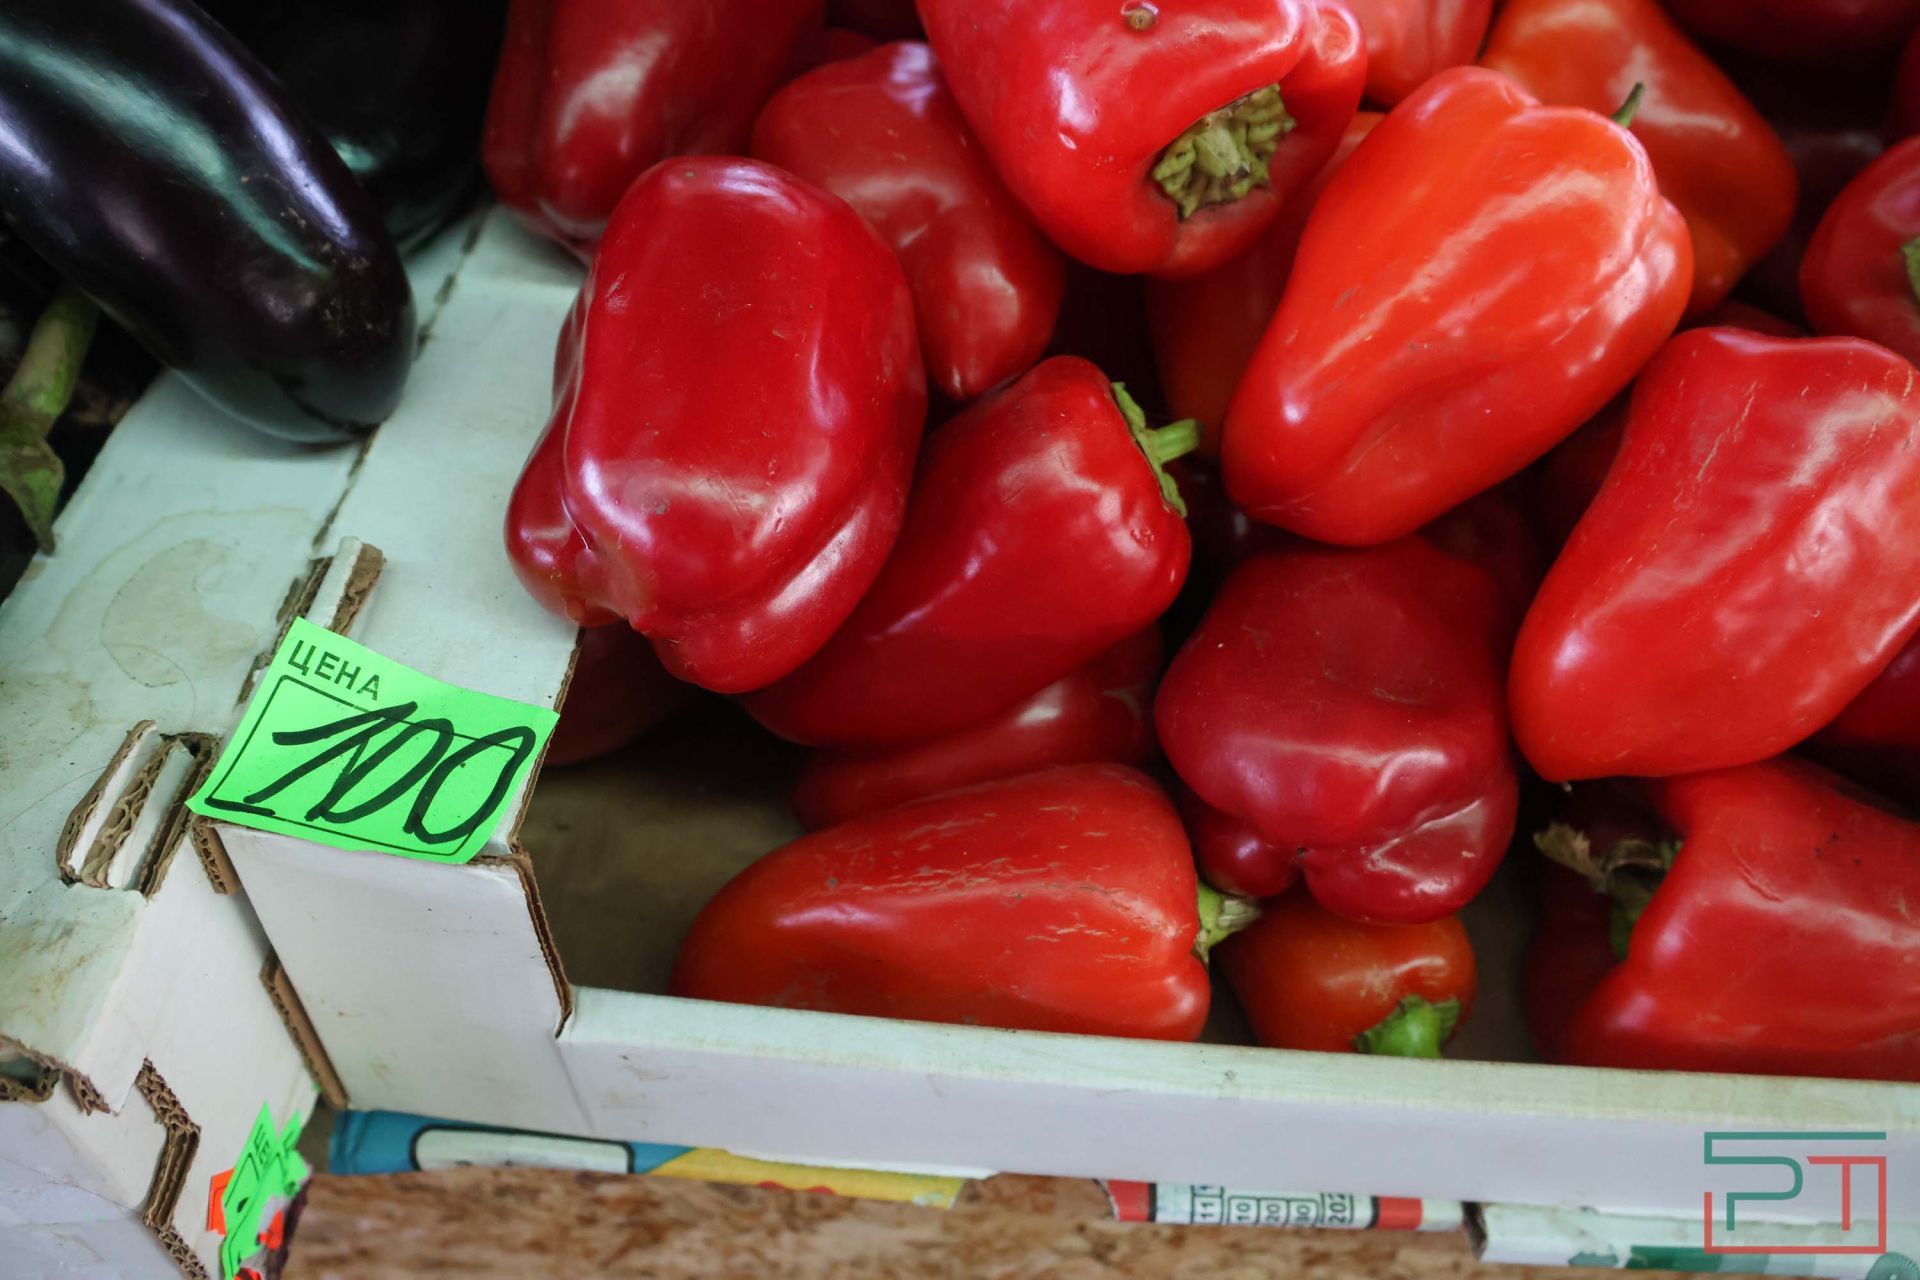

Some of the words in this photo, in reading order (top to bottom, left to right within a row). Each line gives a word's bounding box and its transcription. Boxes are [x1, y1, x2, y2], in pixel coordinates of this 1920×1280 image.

[287, 639, 380, 701] ЦЕНА
[243, 700, 537, 845] 100
[1235, 1201, 1251, 1223] 10
